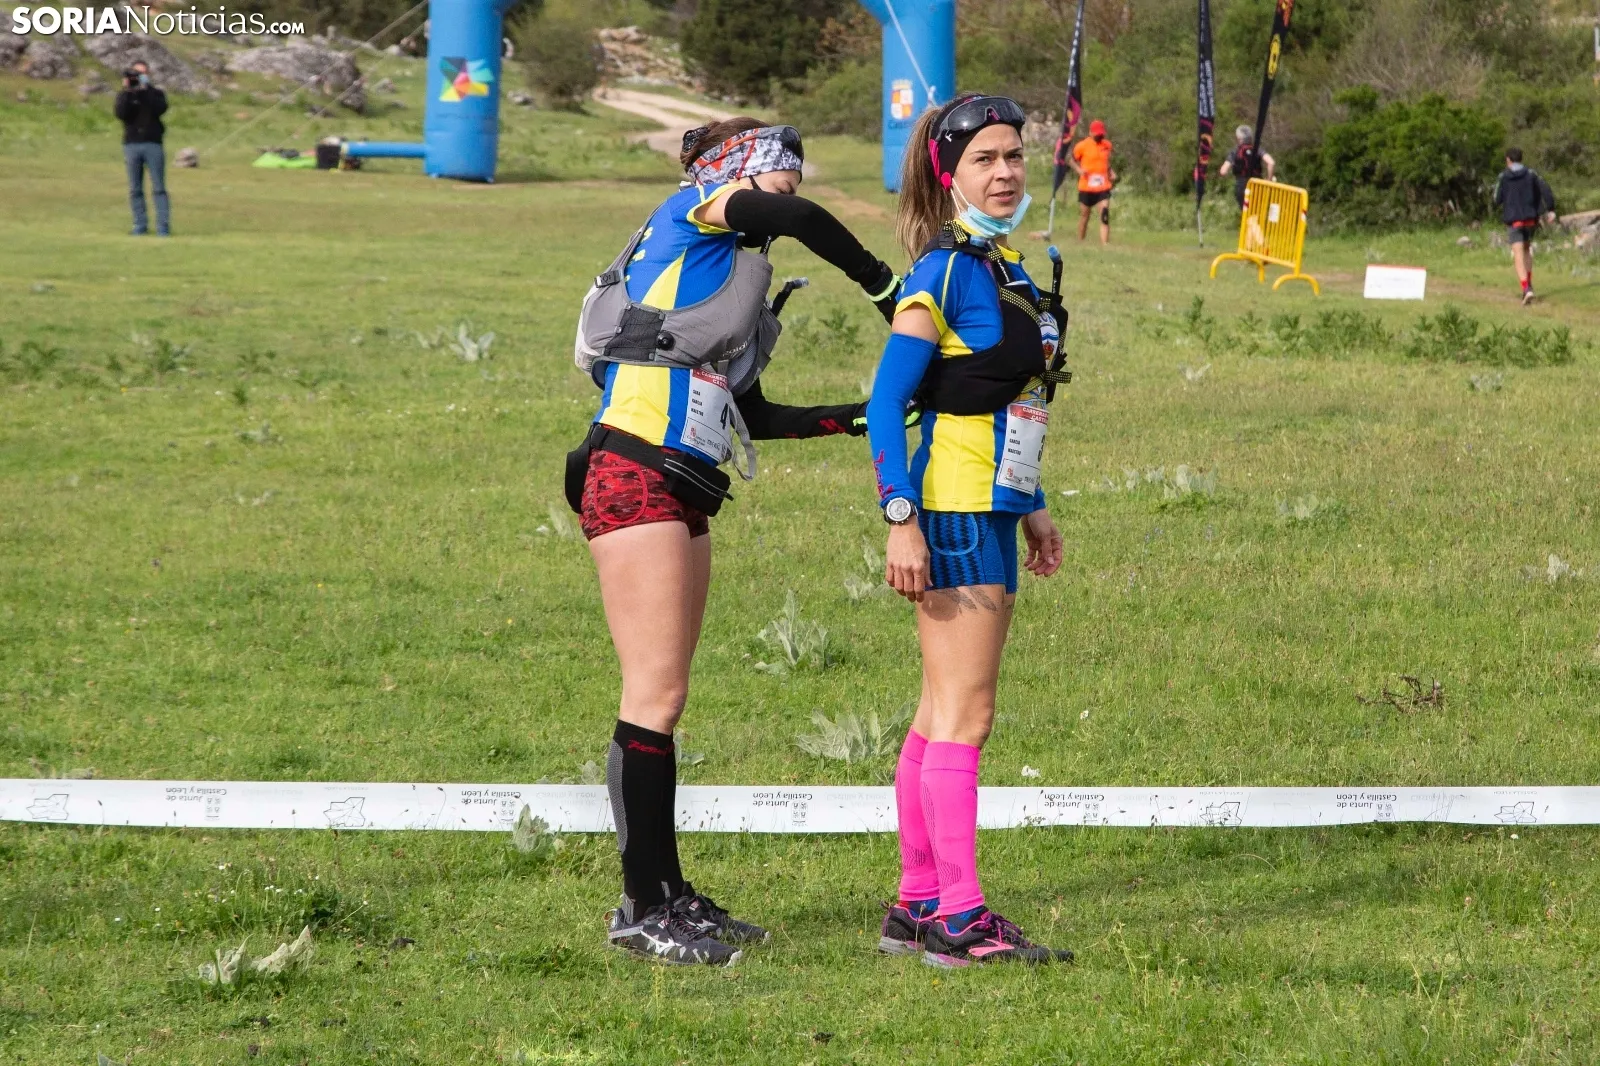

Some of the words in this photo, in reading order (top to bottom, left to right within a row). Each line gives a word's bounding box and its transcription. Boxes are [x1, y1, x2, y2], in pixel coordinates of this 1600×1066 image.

[196, 788, 227, 796] Castilla
[491, 791, 521, 799] Castilla
[776, 791, 781, 799] y
[1067, 791, 1073, 800] y
[1359, 792, 1365, 800] y
[783, 793, 813, 801] Castilla
[1074, 793, 1105, 801] Castilla
[1366, 794, 1397, 802] Castilla
[473, 798, 497, 806] Junta
[766, 800, 790, 808] Junta
[1057, 801, 1082, 809] Junta
